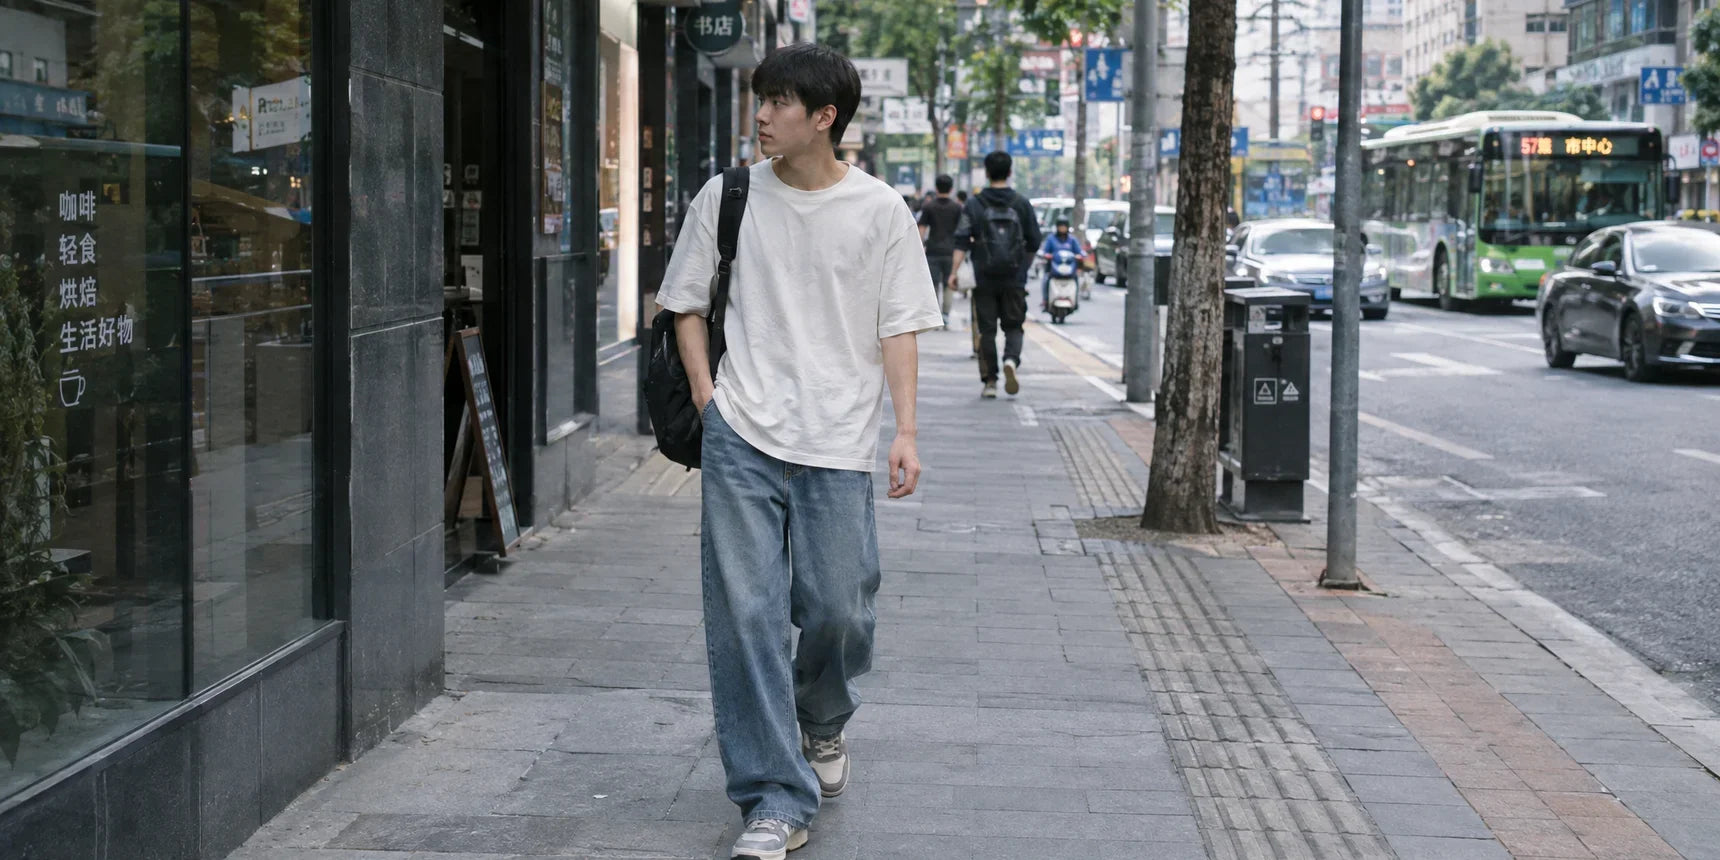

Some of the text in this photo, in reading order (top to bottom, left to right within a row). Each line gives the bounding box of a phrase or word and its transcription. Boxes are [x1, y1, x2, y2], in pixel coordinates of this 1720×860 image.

[694, 15, 733, 36] 书店
[1565, 136, 1613, 155] 市中心
[59, 190, 96, 222] 咖啡
[59, 232, 96, 265] 轻食
[59, 276, 96, 310] 烘焙
[59, 314, 133, 354] 生活好物
